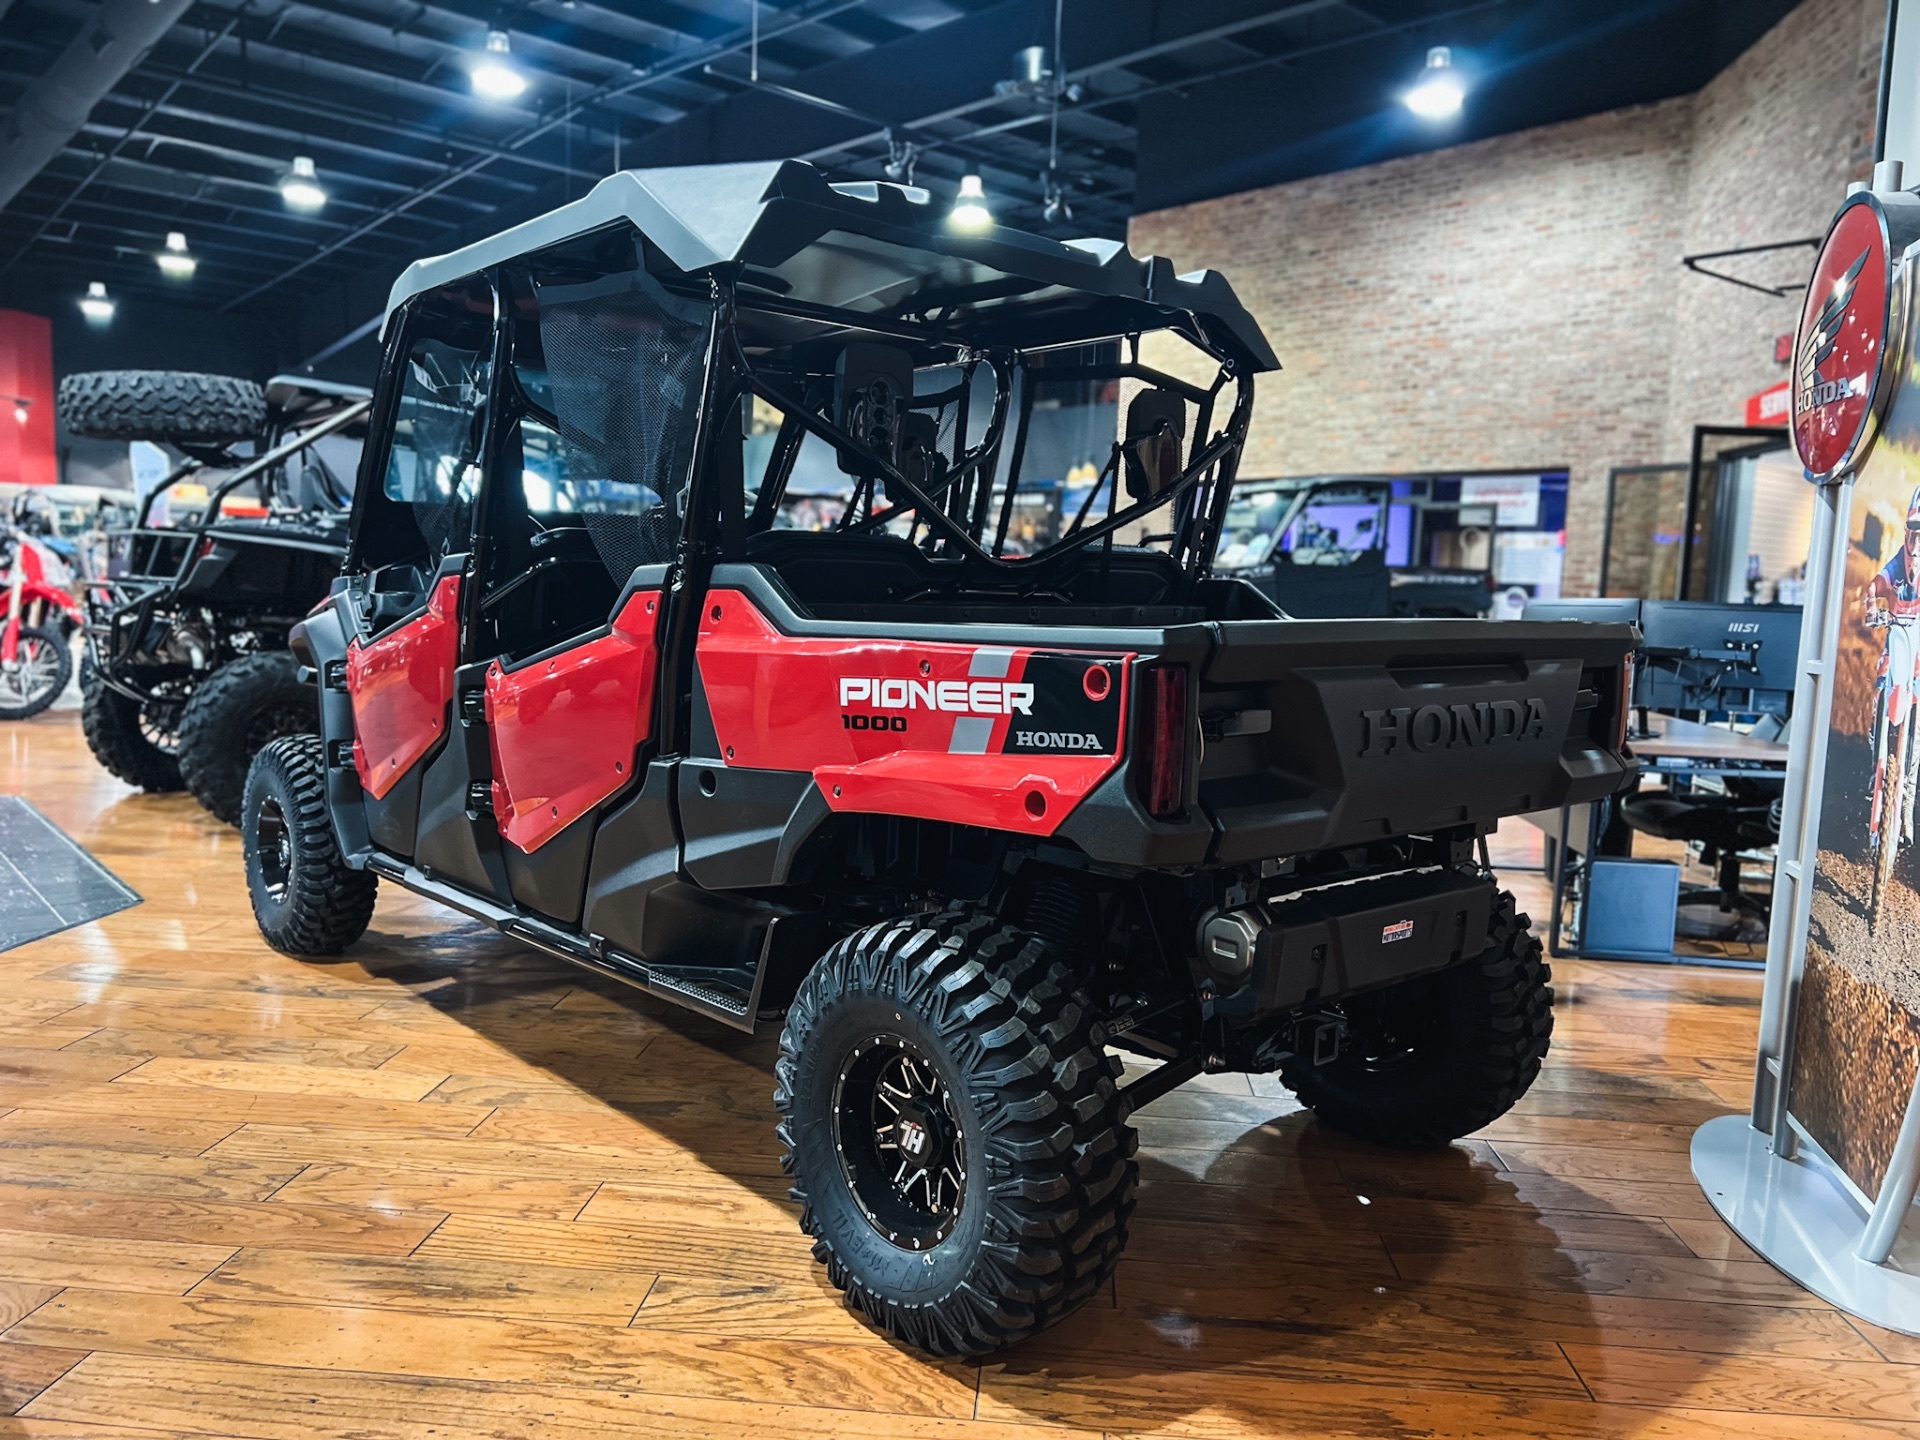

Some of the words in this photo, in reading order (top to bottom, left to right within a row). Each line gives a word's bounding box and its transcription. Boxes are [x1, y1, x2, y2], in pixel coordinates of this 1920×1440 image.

[1796, 377, 1854, 415] HONDA
[839, 678, 1034, 715] PIONEER
[841, 714, 907, 732] 1000
[1016, 731, 1103, 750] HONDA
[1363, 698, 1549, 757] HONDA
